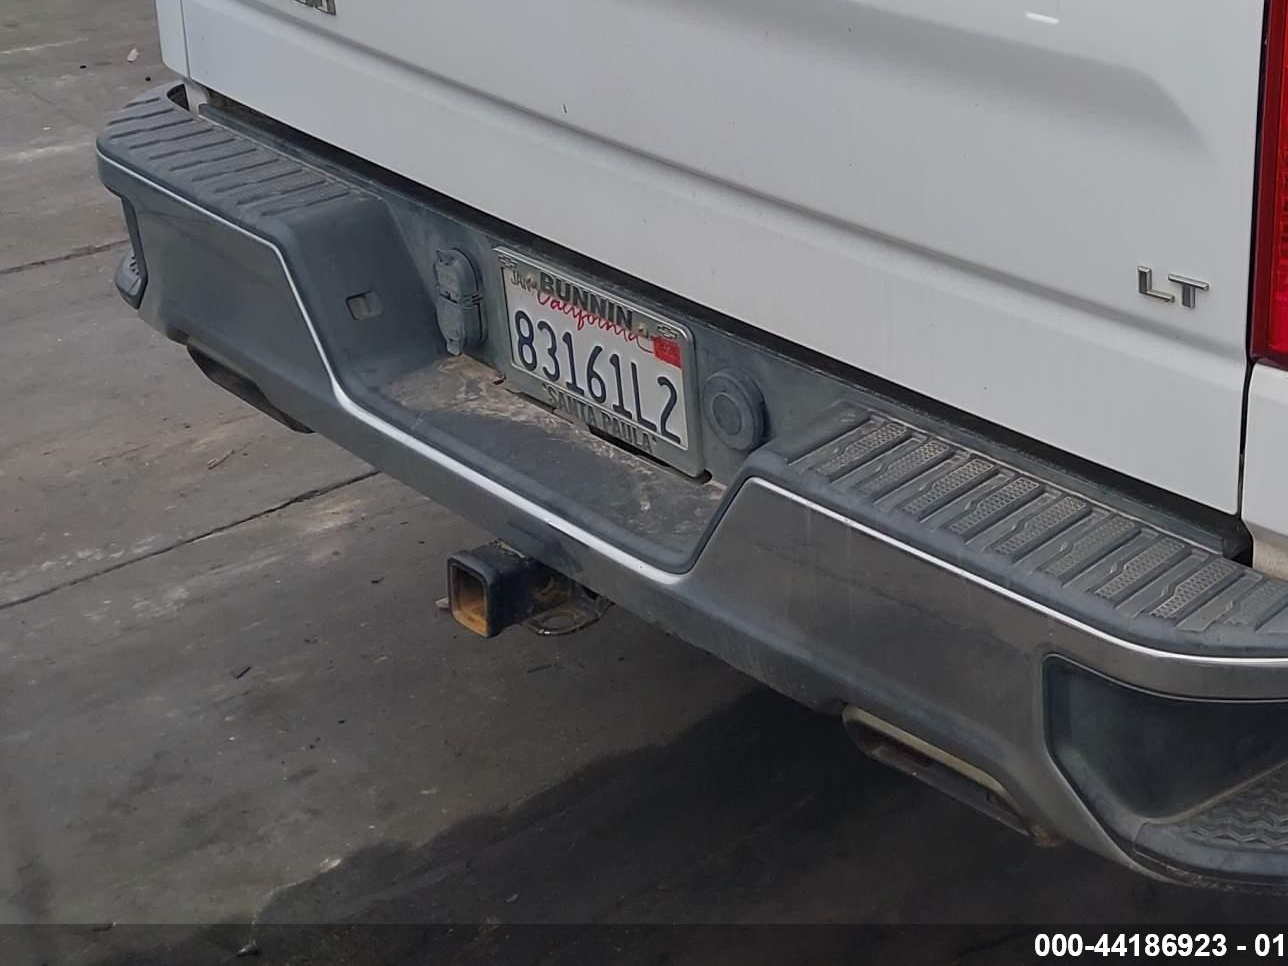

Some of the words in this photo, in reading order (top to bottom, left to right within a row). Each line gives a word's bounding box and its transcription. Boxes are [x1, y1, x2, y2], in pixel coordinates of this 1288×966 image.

[538, 271, 634, 330] BUNNIN
[1137, 266, 1210, 309] LT
[514, 310, 681, 445] 83161L2
